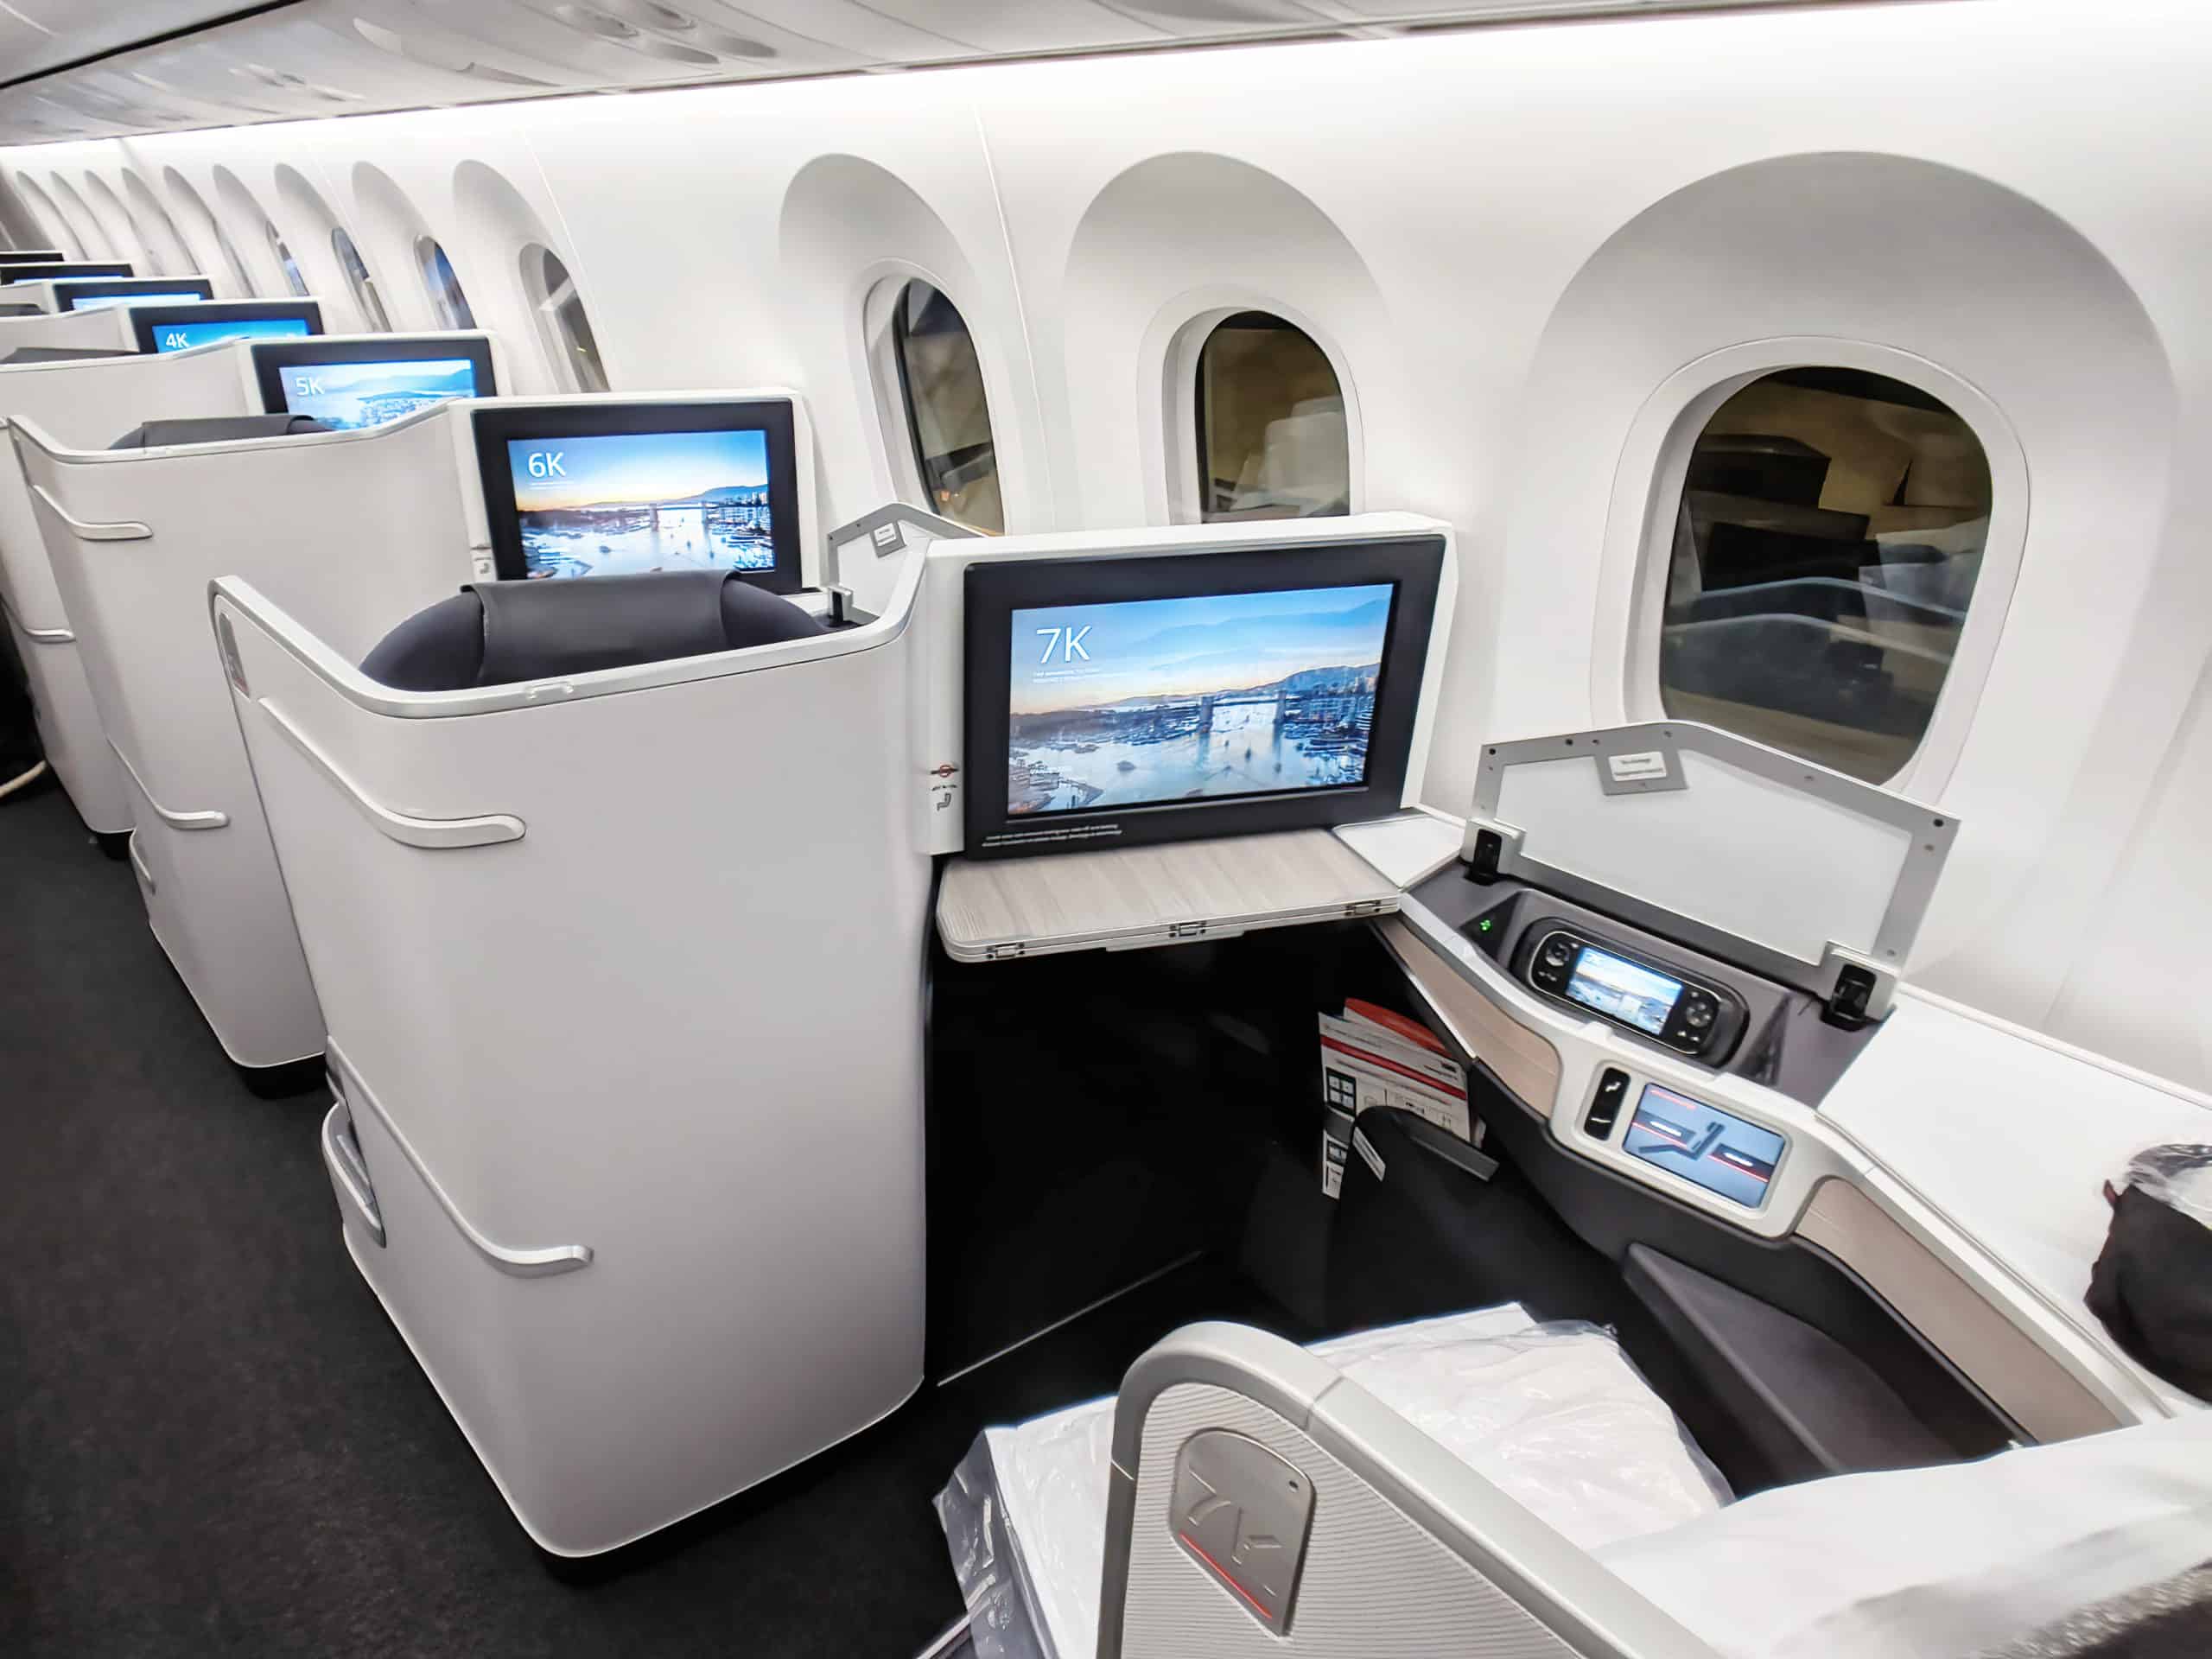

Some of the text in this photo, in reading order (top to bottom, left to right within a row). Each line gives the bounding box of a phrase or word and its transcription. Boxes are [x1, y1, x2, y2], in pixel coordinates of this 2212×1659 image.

[166, 332, 189, 348] 4K
[296, 377, 325, 396] 5K
[529, 452, 566, 477] 6K
[1036, 625, 1091, 664] 7K
[1186, 1467, 1283, 1598] 7K
